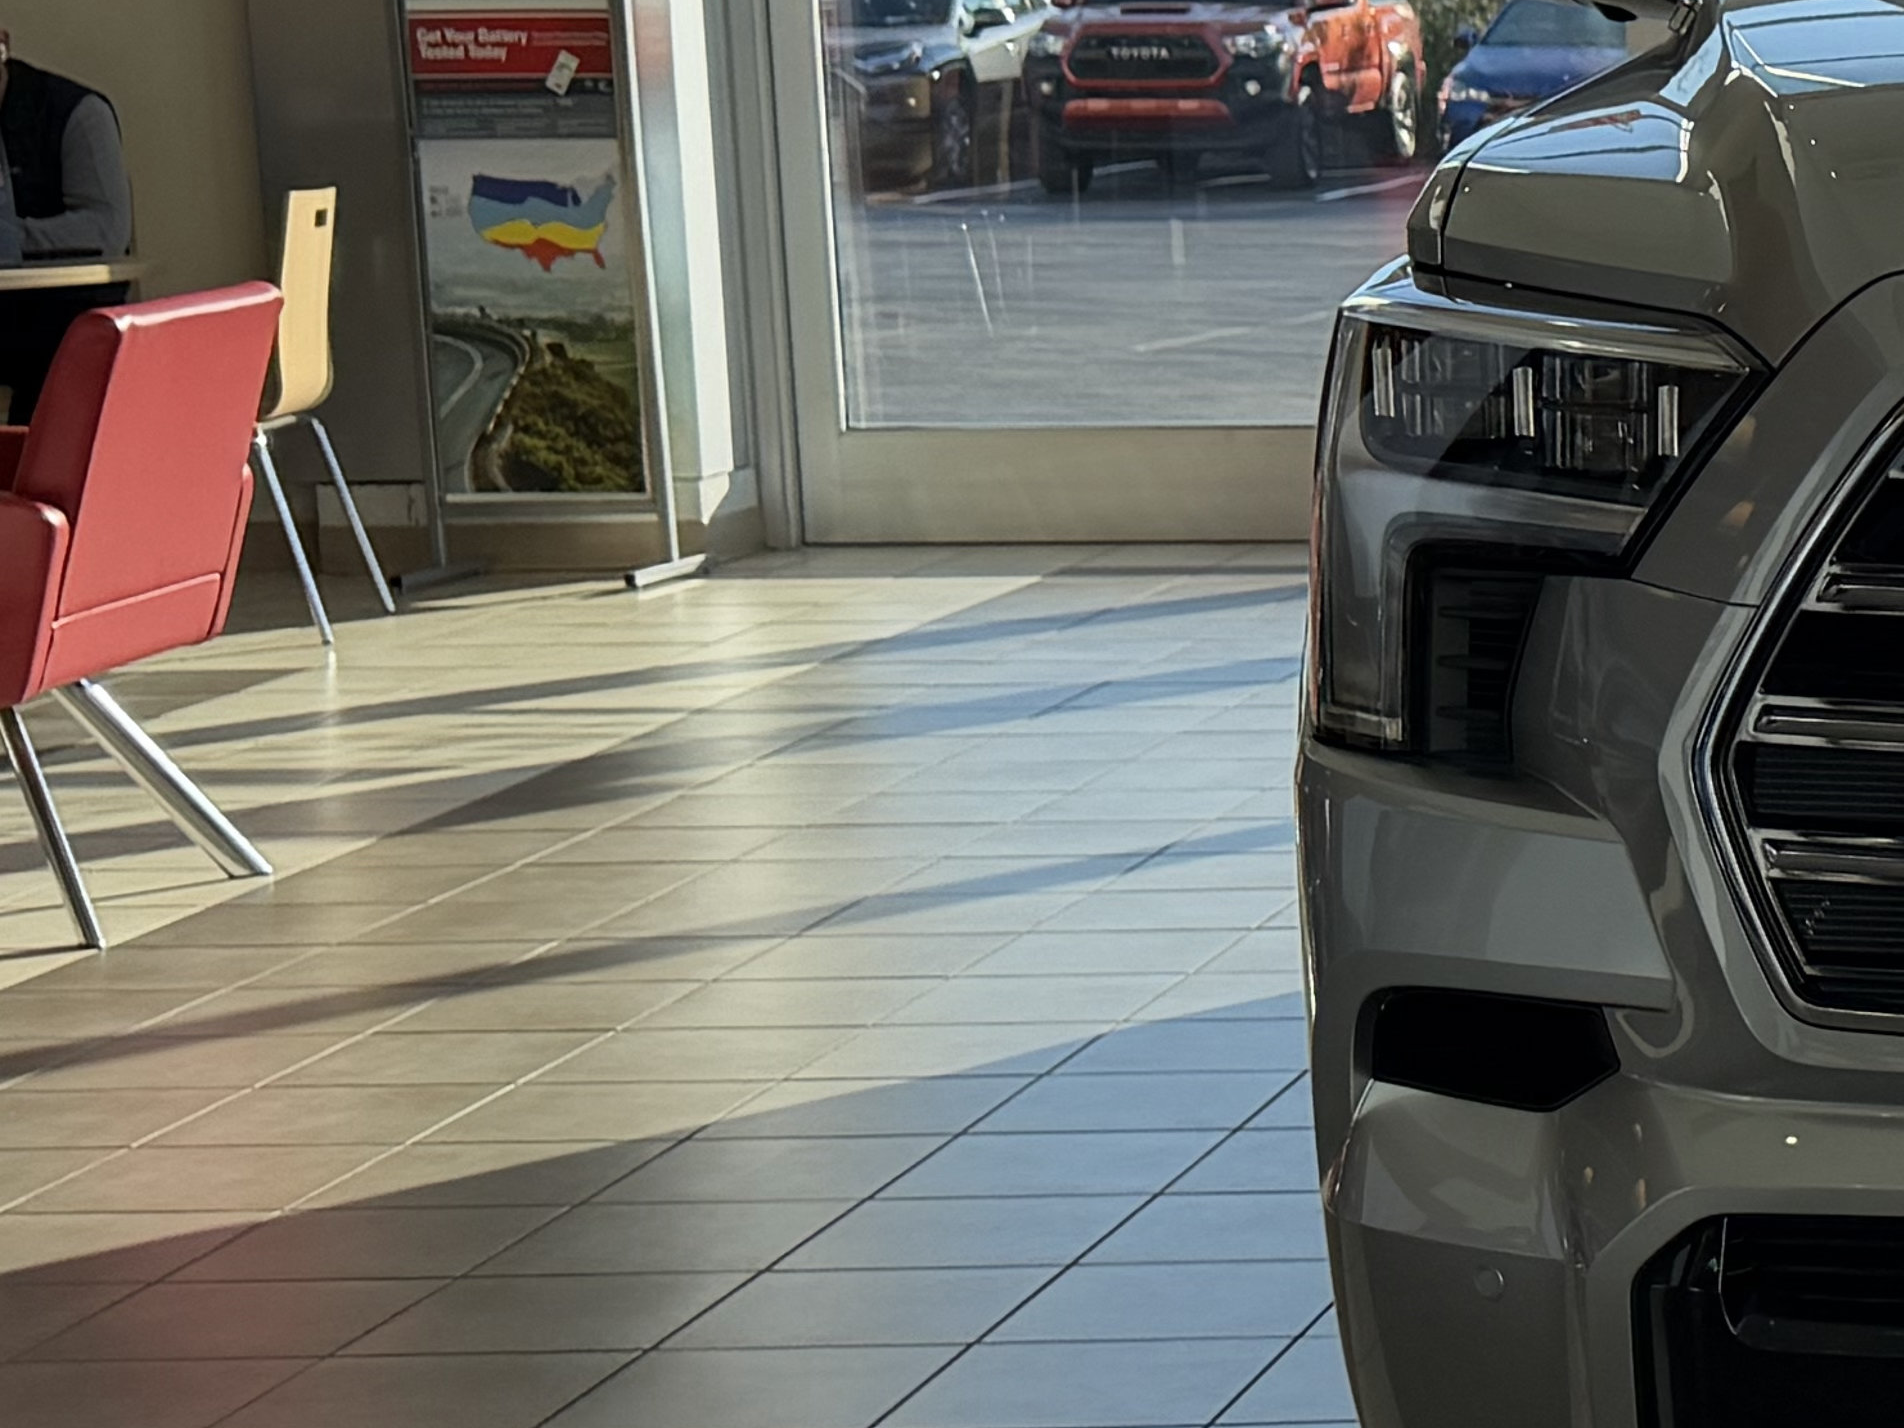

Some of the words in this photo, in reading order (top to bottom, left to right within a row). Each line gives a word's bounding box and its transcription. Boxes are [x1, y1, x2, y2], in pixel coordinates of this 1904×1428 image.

[416, 27, 442, 45] Get
[442, 27, 475, 45] Your
[477, 26, 529, 47] Battery
[418, 44, 466, 60] Tested
[466, 44, 508, 63] Today
[1110, 46, 1170, 60] TOYOTA
